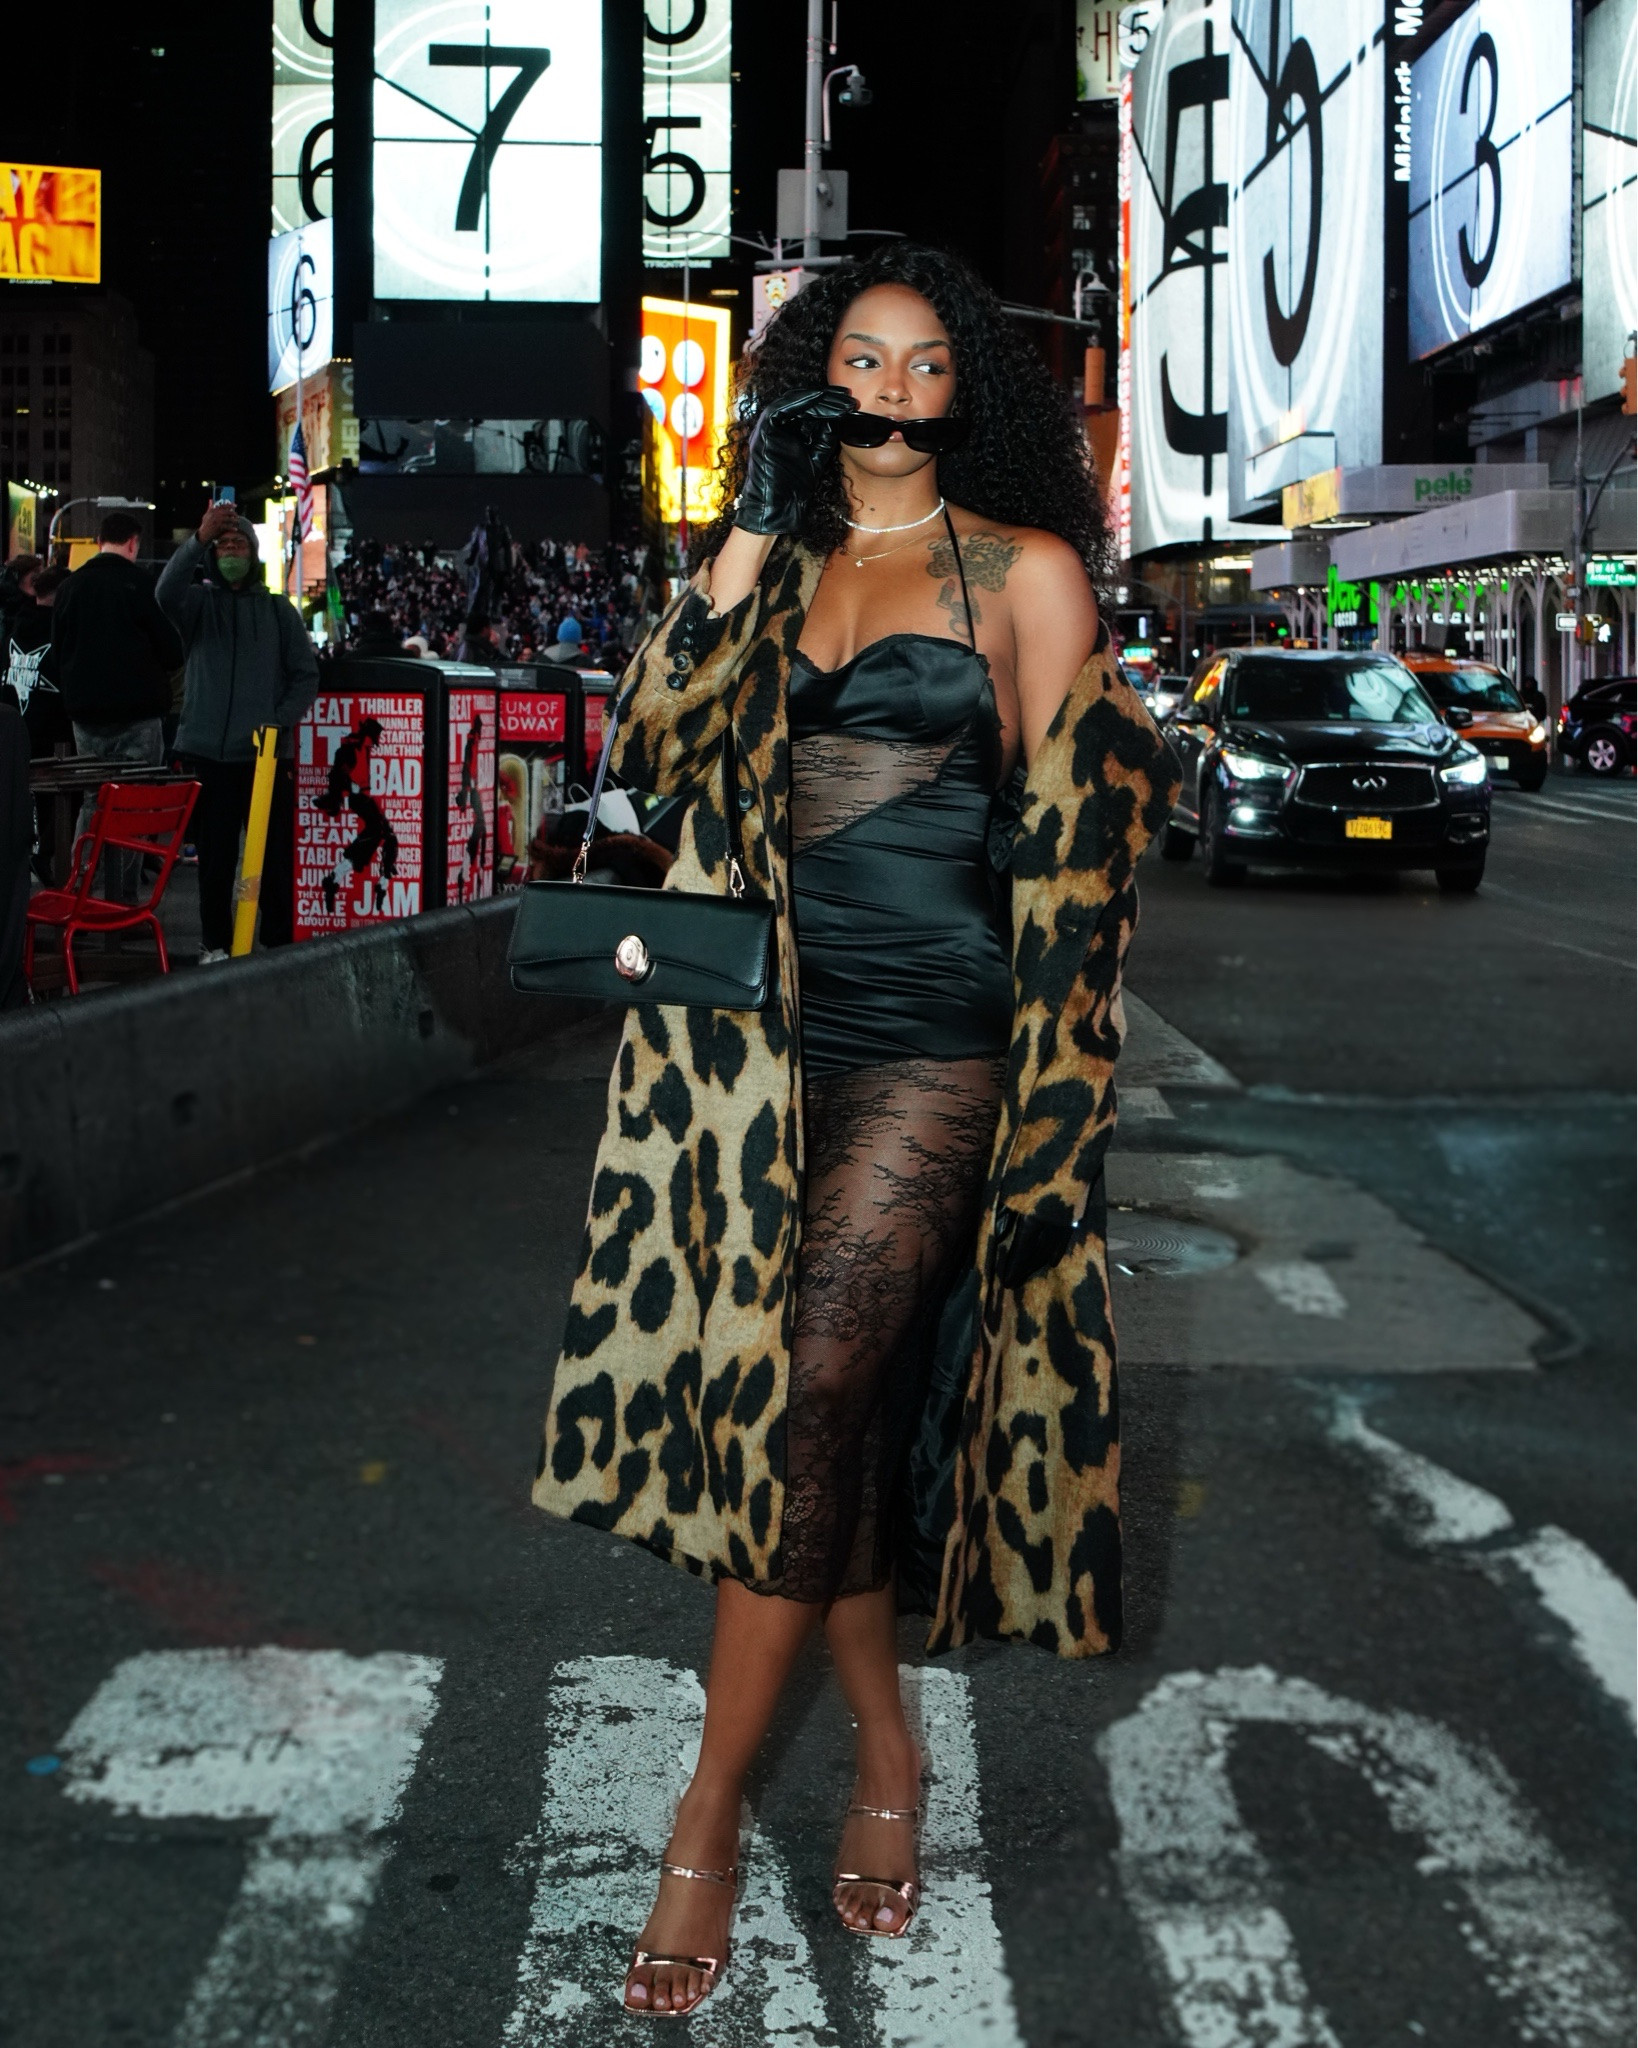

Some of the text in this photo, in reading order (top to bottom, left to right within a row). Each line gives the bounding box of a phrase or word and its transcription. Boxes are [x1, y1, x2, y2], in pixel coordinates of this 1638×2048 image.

[1129, 11, 1150, 54] 5
[429, 44, 551, 232] 7
[1459, 32, 1502, 289] 3
[644, 116, 706, 227] 5
[292, 254, 316, 350] 6
[358, 698, 423, 715] THRILLER
[536, 701, 559, 715] OF
[411, 718, 423, 731] BE
[299, 725, 352, 766] IT
[298, 776, 330, 785] MIRRO
[370, 758, 422, 797] BAD
[298, 812, 359, 828] BILLIE
[385, 809, 422, 821] BACK
[298, 827, 358, 845] JEAN
[297, 847, 346, 866] TABLO
[297, 891, 320, 899] THEY
[353, 880, 421, 917] JAM
[297, 917, 331, 927] ABOUT
[333, 917, 347, 928] US
